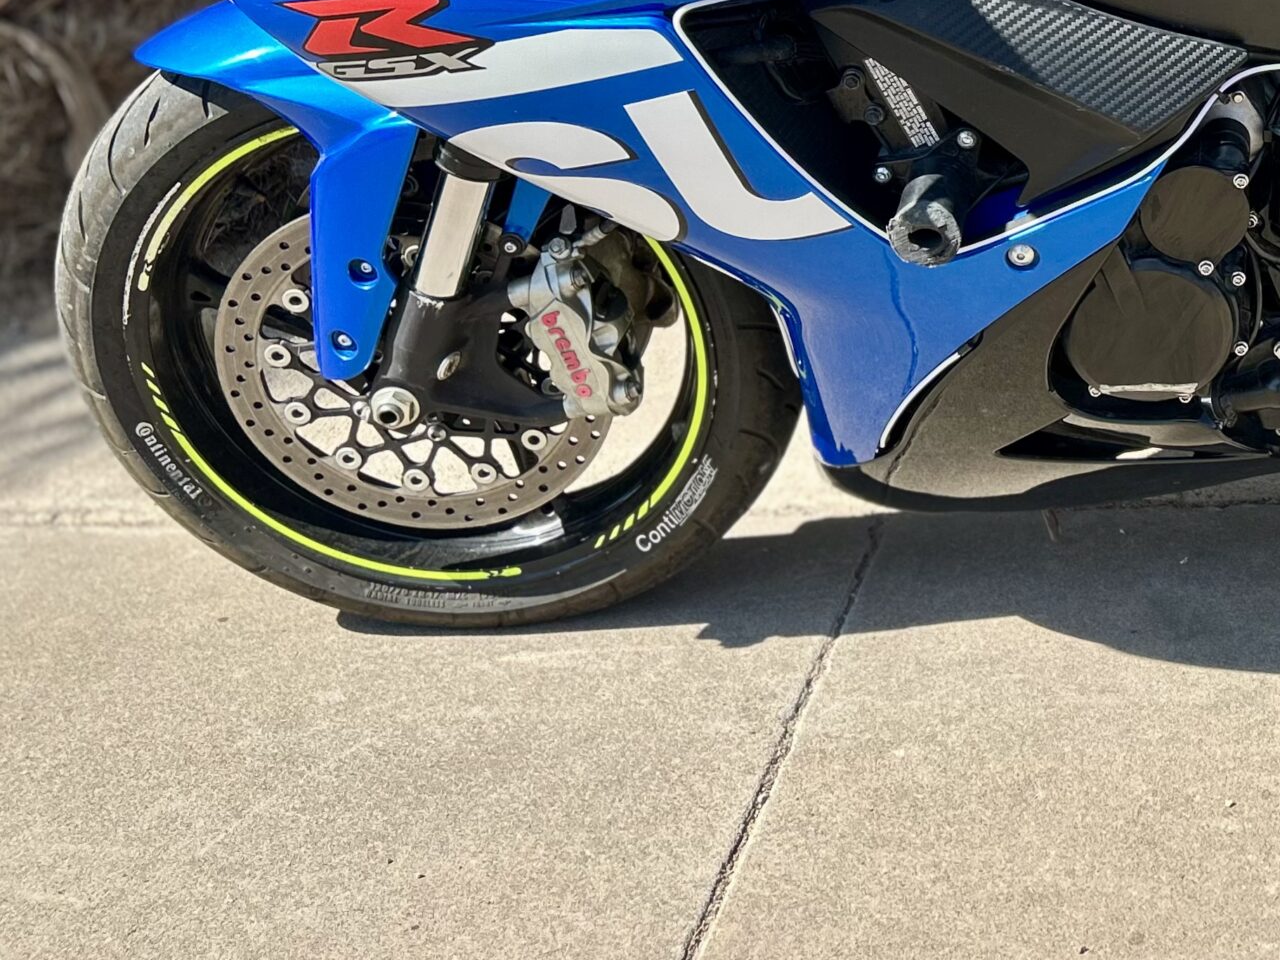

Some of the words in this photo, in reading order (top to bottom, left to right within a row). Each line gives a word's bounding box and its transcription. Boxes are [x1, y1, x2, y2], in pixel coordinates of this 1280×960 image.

[316, 46, 481, 80] GSX
[541, 310, 593, 398] brembo
[135, 422, 203, 499] Continental
